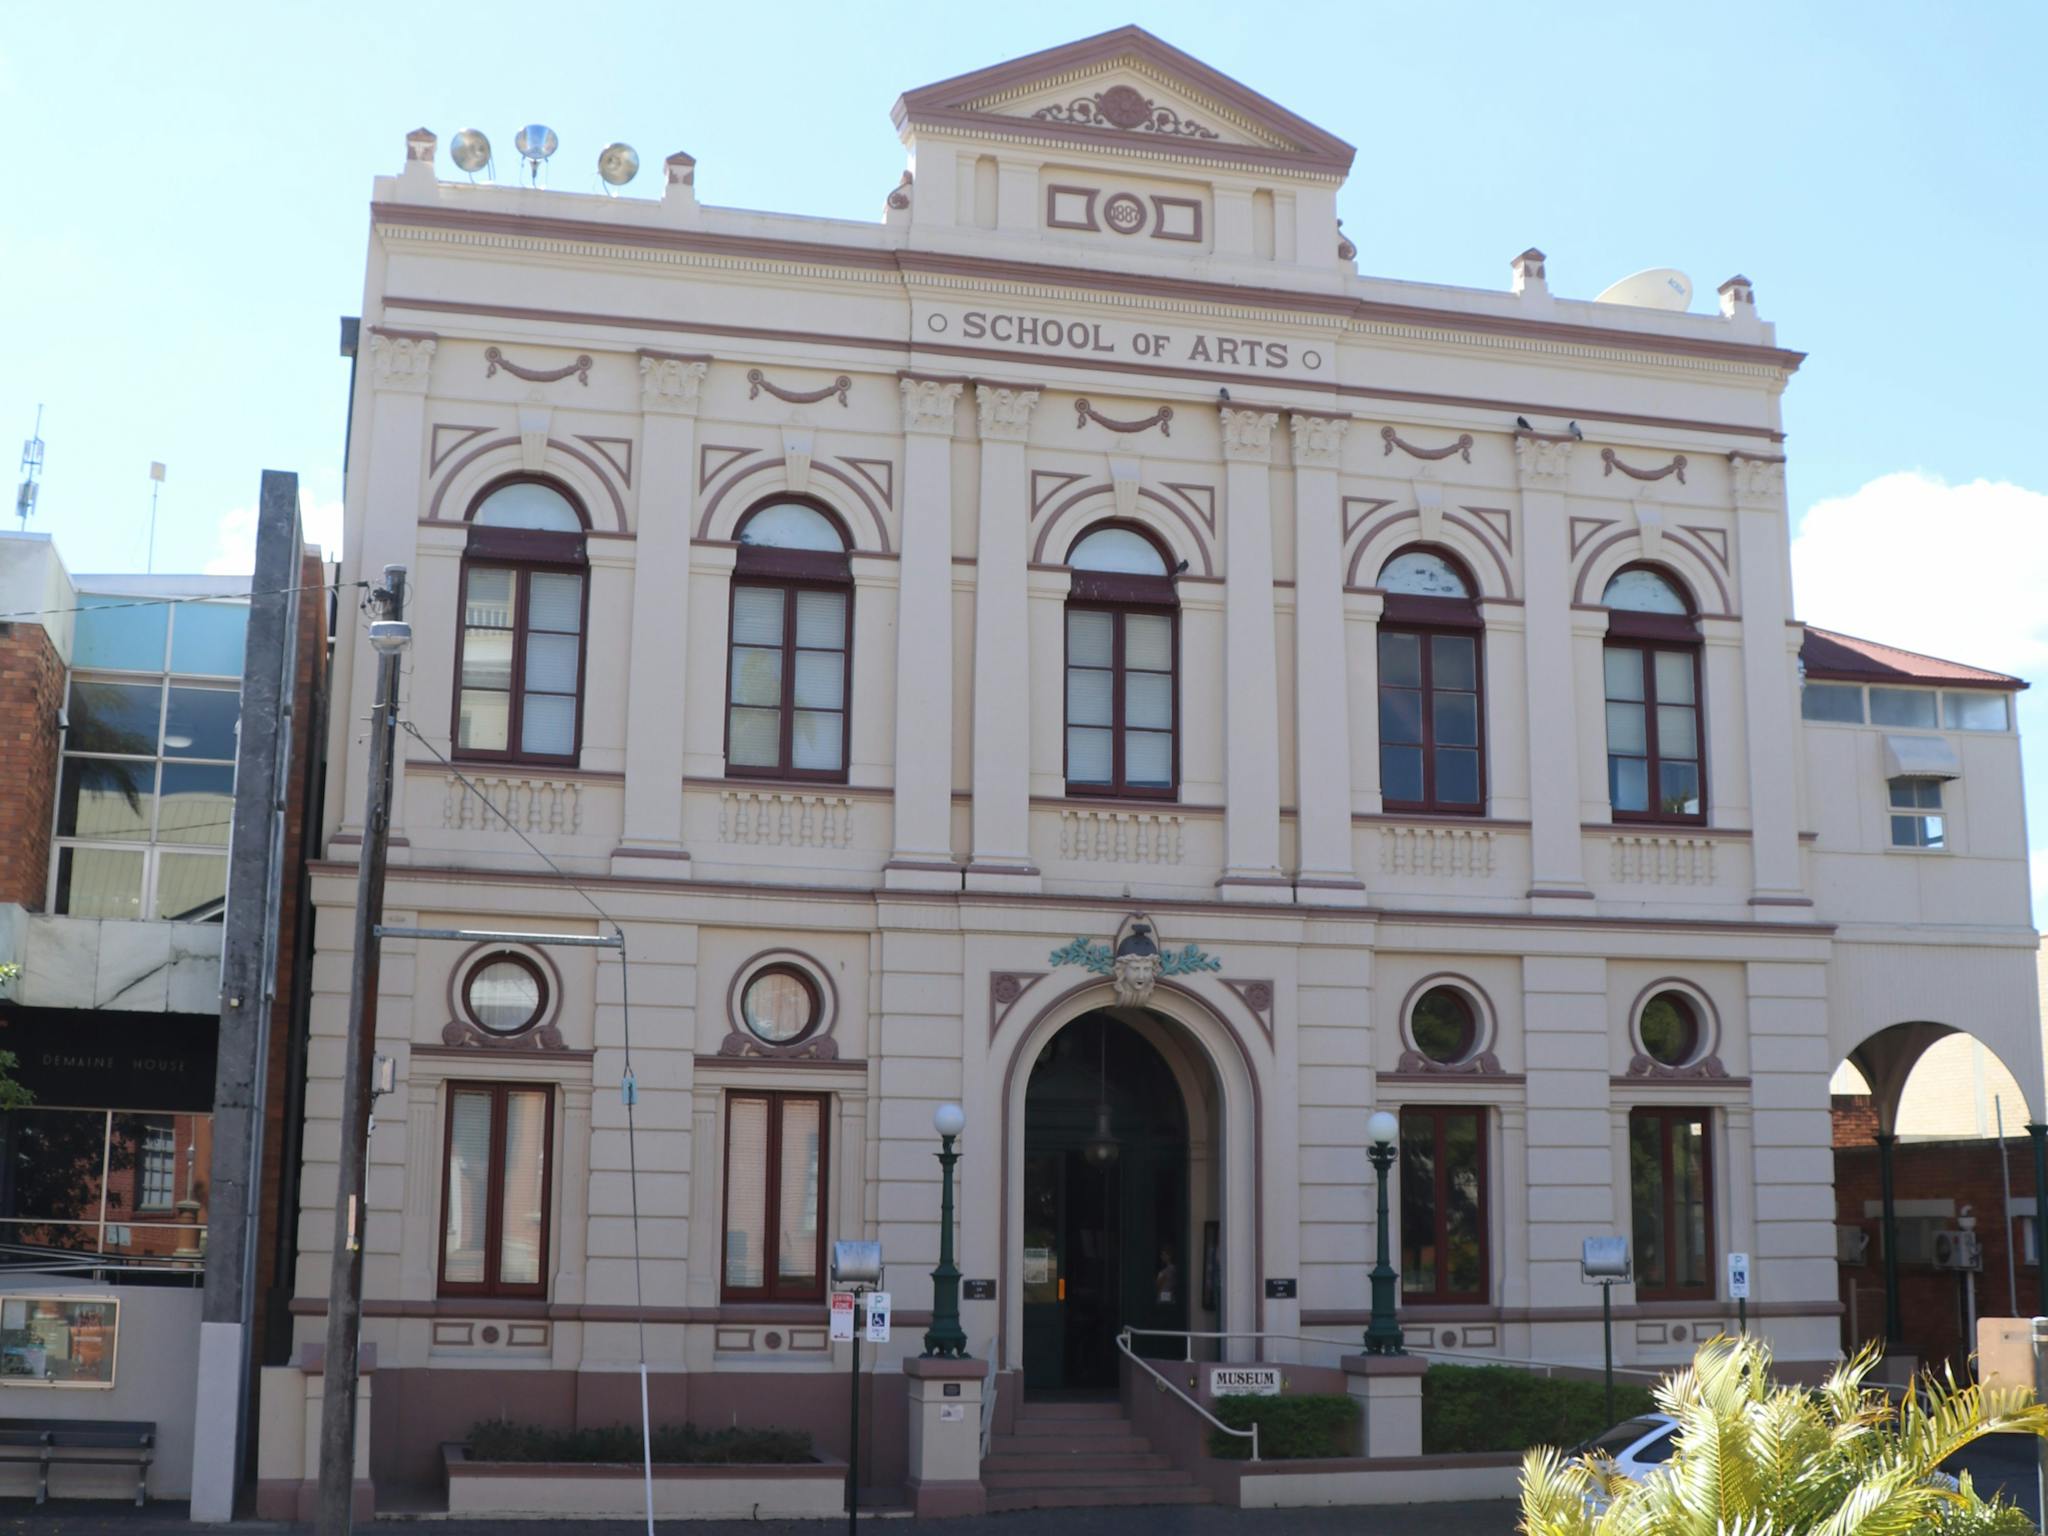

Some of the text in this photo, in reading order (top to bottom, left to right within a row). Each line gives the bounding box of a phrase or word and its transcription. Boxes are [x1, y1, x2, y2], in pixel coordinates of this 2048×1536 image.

[962, 311, 1290, 369] SCHOOL OF ARTS
[42, 1054, 186, 1072] DEMAINE HOUSE
[1216, 1372, 1275, 1385] MUSEUM
